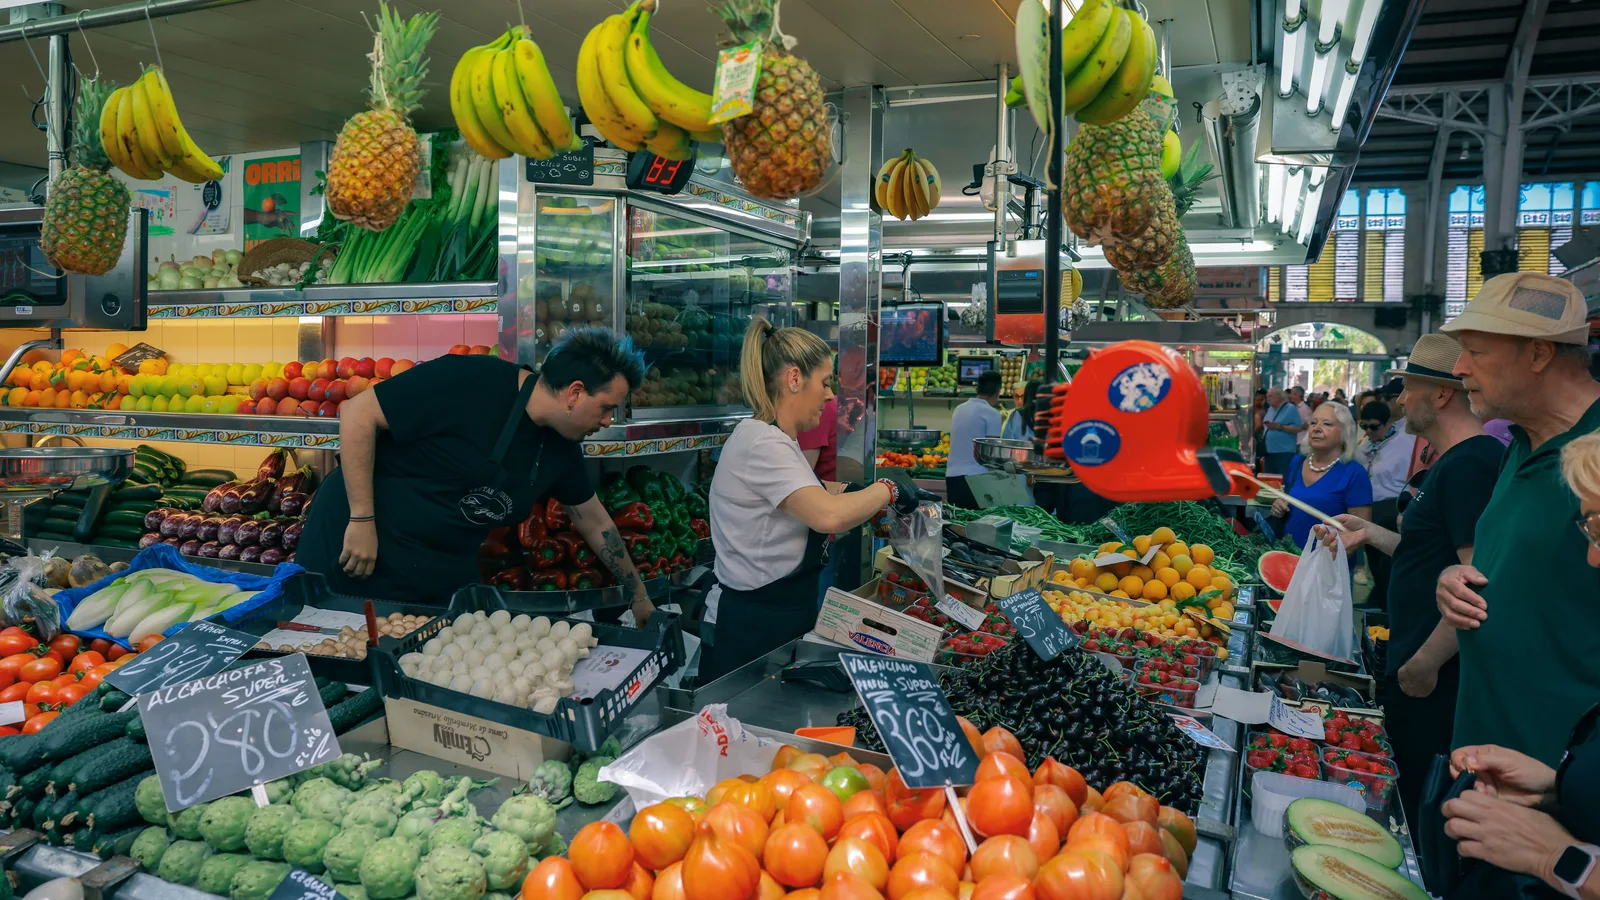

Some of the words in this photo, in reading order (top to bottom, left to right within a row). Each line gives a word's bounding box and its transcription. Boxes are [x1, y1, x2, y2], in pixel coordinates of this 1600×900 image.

[848, 630, 897, 656] VALENCIA
[850, 657, 917, 674] VALENCIANO
[147, 660, 284, 711] ALCACHOFAS
[444, 716, 478, 731] Membrillo
[479, 726, 487, 735] de
[433, 723, 473, 755] Emily
[488, 730, 508, 740] Carne
